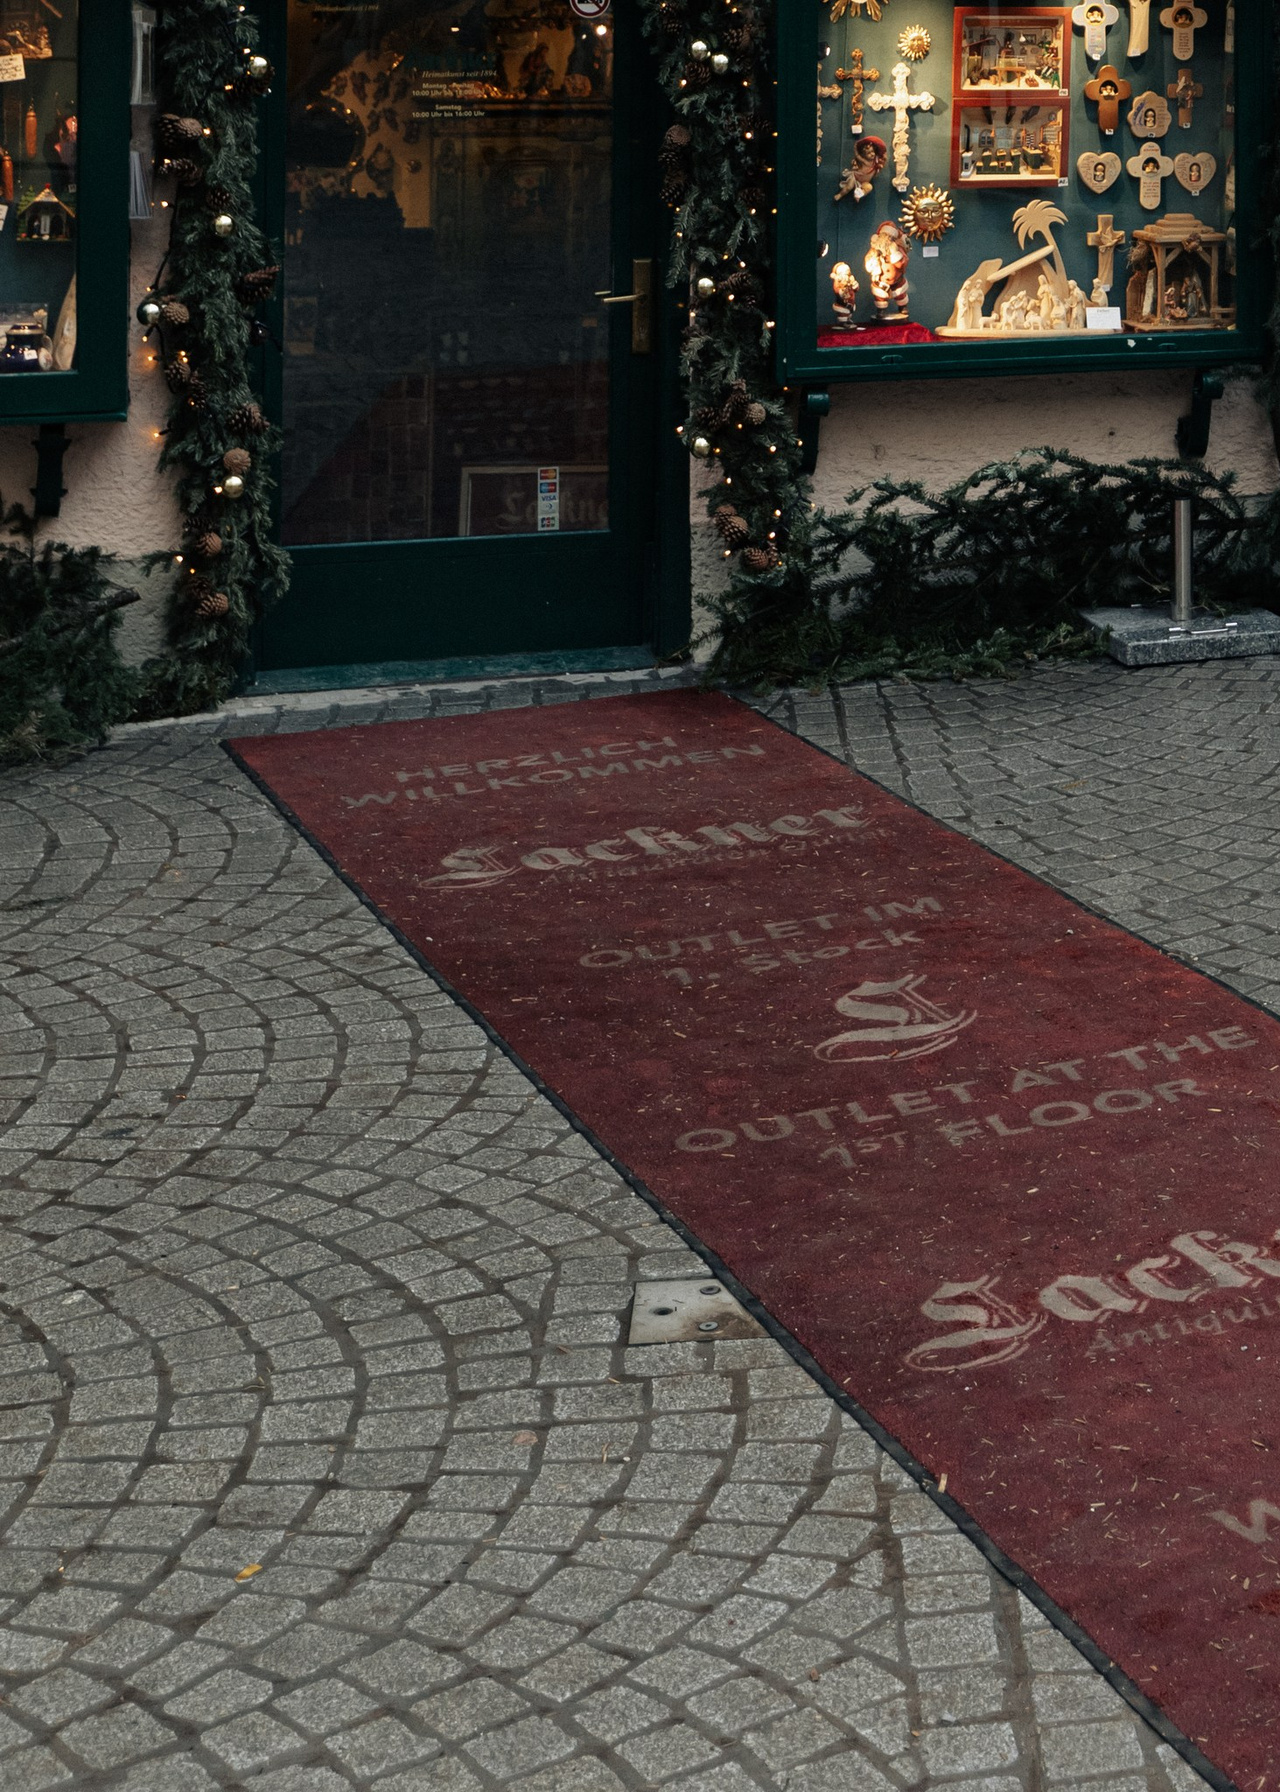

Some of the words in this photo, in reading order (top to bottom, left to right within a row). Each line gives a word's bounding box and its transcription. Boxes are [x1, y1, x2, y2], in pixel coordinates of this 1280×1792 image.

[422, 70, 465, 78] Heimatkunst
[341, 744, 767, 808] WILLKOMMEN
[396, 735, 677, 783] HERZLICH
[418, 802, 877, 890] Lackner
[579, 912, 841, 969] OUTLET
[864, 896, 945, 924] IM
[744, 928, 926, 975] Stock
[674, 1080, 979, 1154] OUTLET
[1011, 1058, 1086, 1093] AT
[1104, 1025, 1260, 1073] THE
[937, 1077, 1210, 1147] FLOOR
